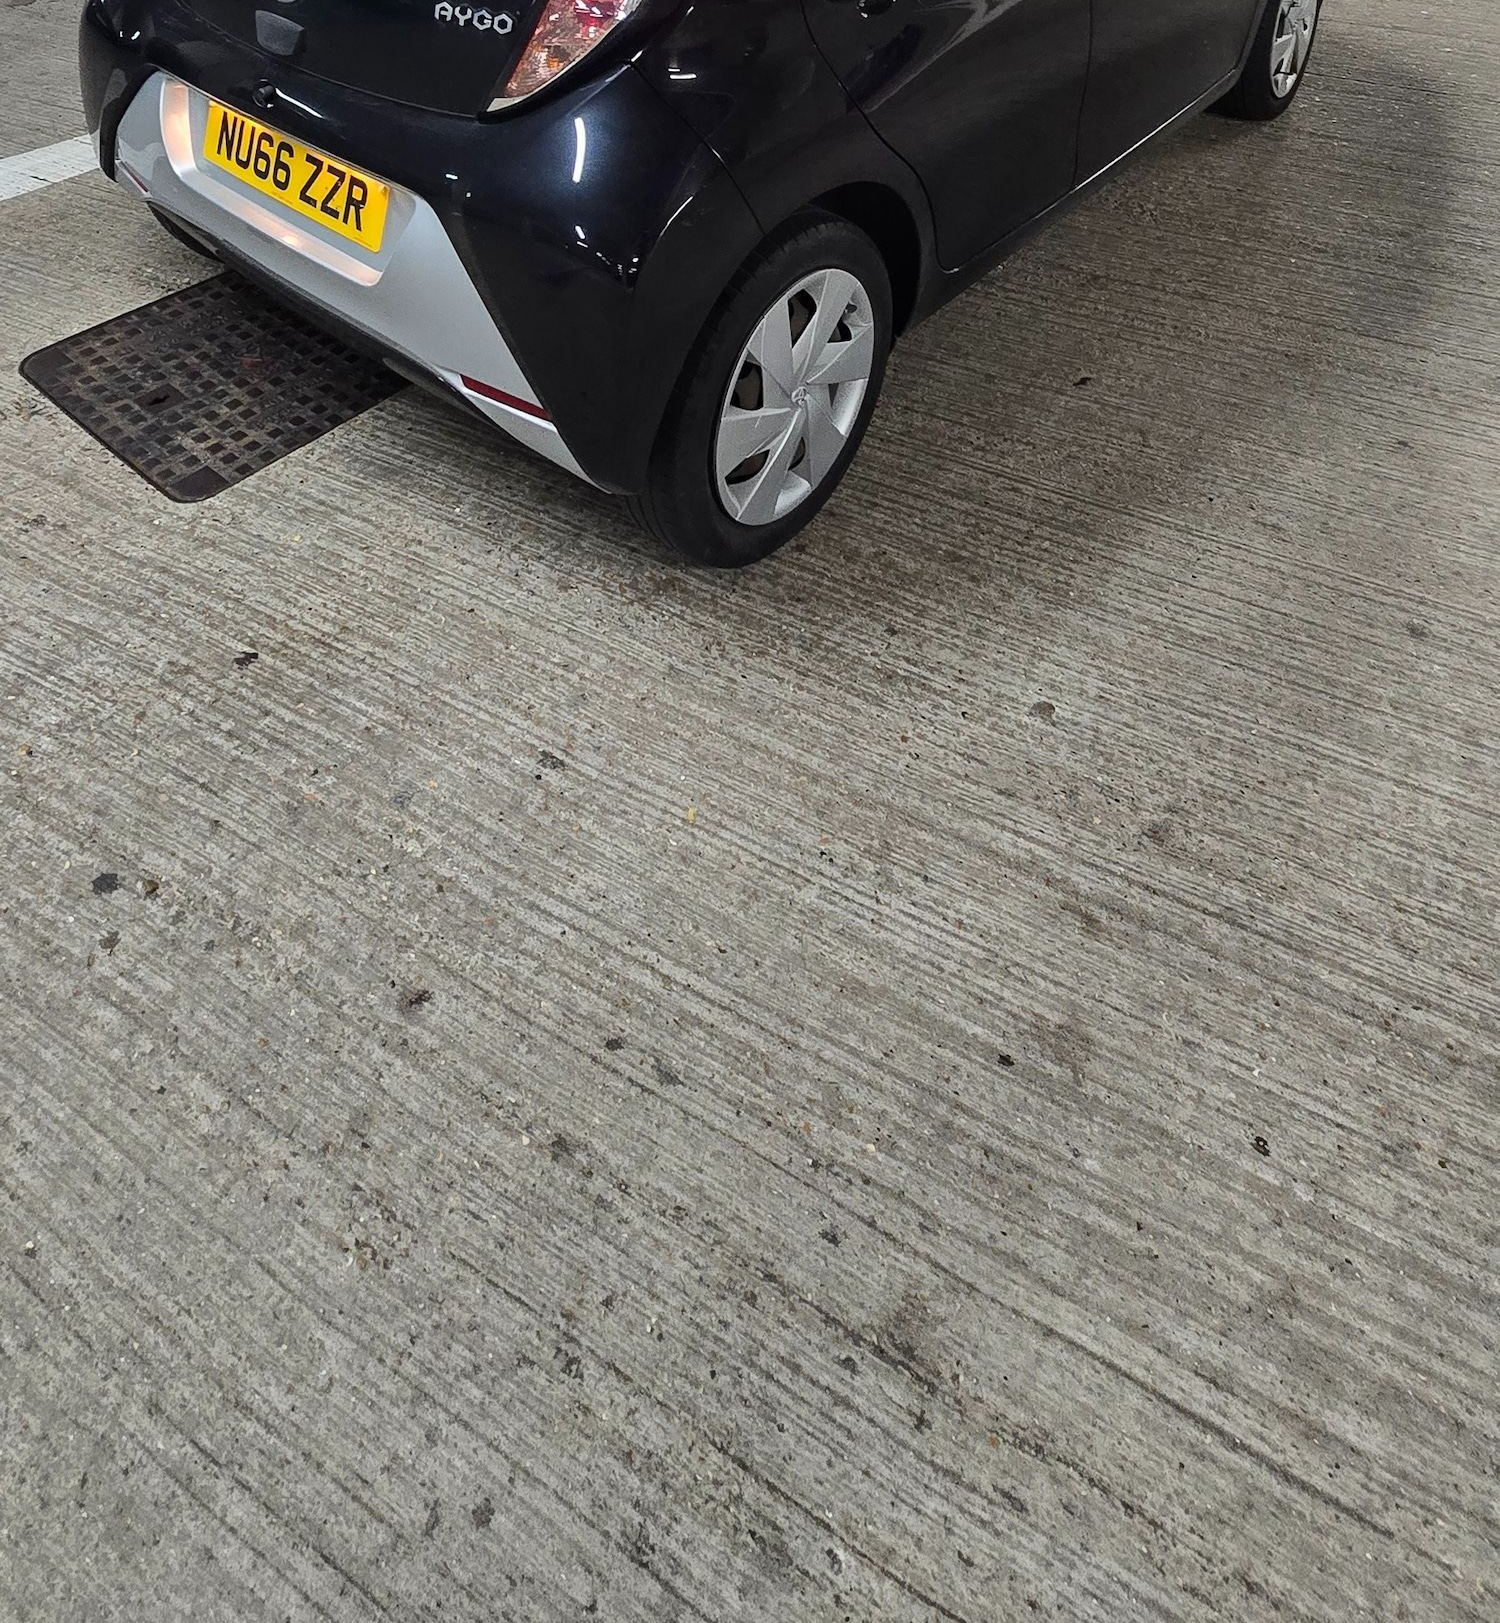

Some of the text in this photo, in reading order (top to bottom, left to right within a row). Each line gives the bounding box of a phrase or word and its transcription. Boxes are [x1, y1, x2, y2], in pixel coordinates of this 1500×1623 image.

[434, 1, 513, 34] AYGO
[216, 110, 368, 232] NU66 ZZR
